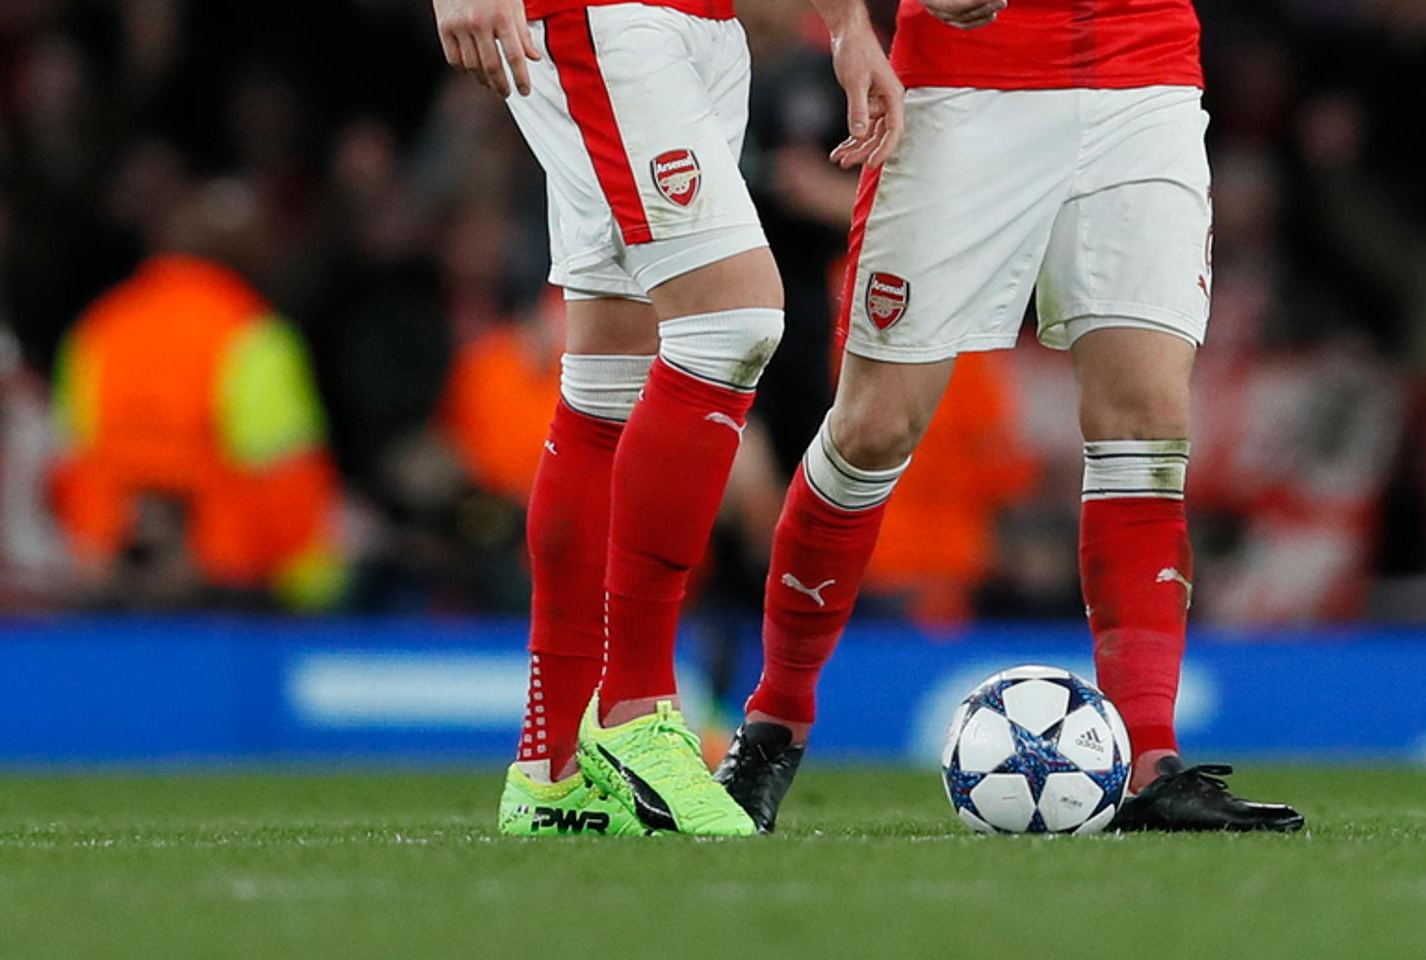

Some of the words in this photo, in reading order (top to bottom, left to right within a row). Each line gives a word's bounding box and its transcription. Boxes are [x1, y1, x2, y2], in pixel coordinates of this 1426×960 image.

[655, 153, 689, 168] Arsenal
[869, 279, 901, 294] Arsenal
[1075, 736, 1104, 753] adidas
[531, 806, 611, 836] PWR
